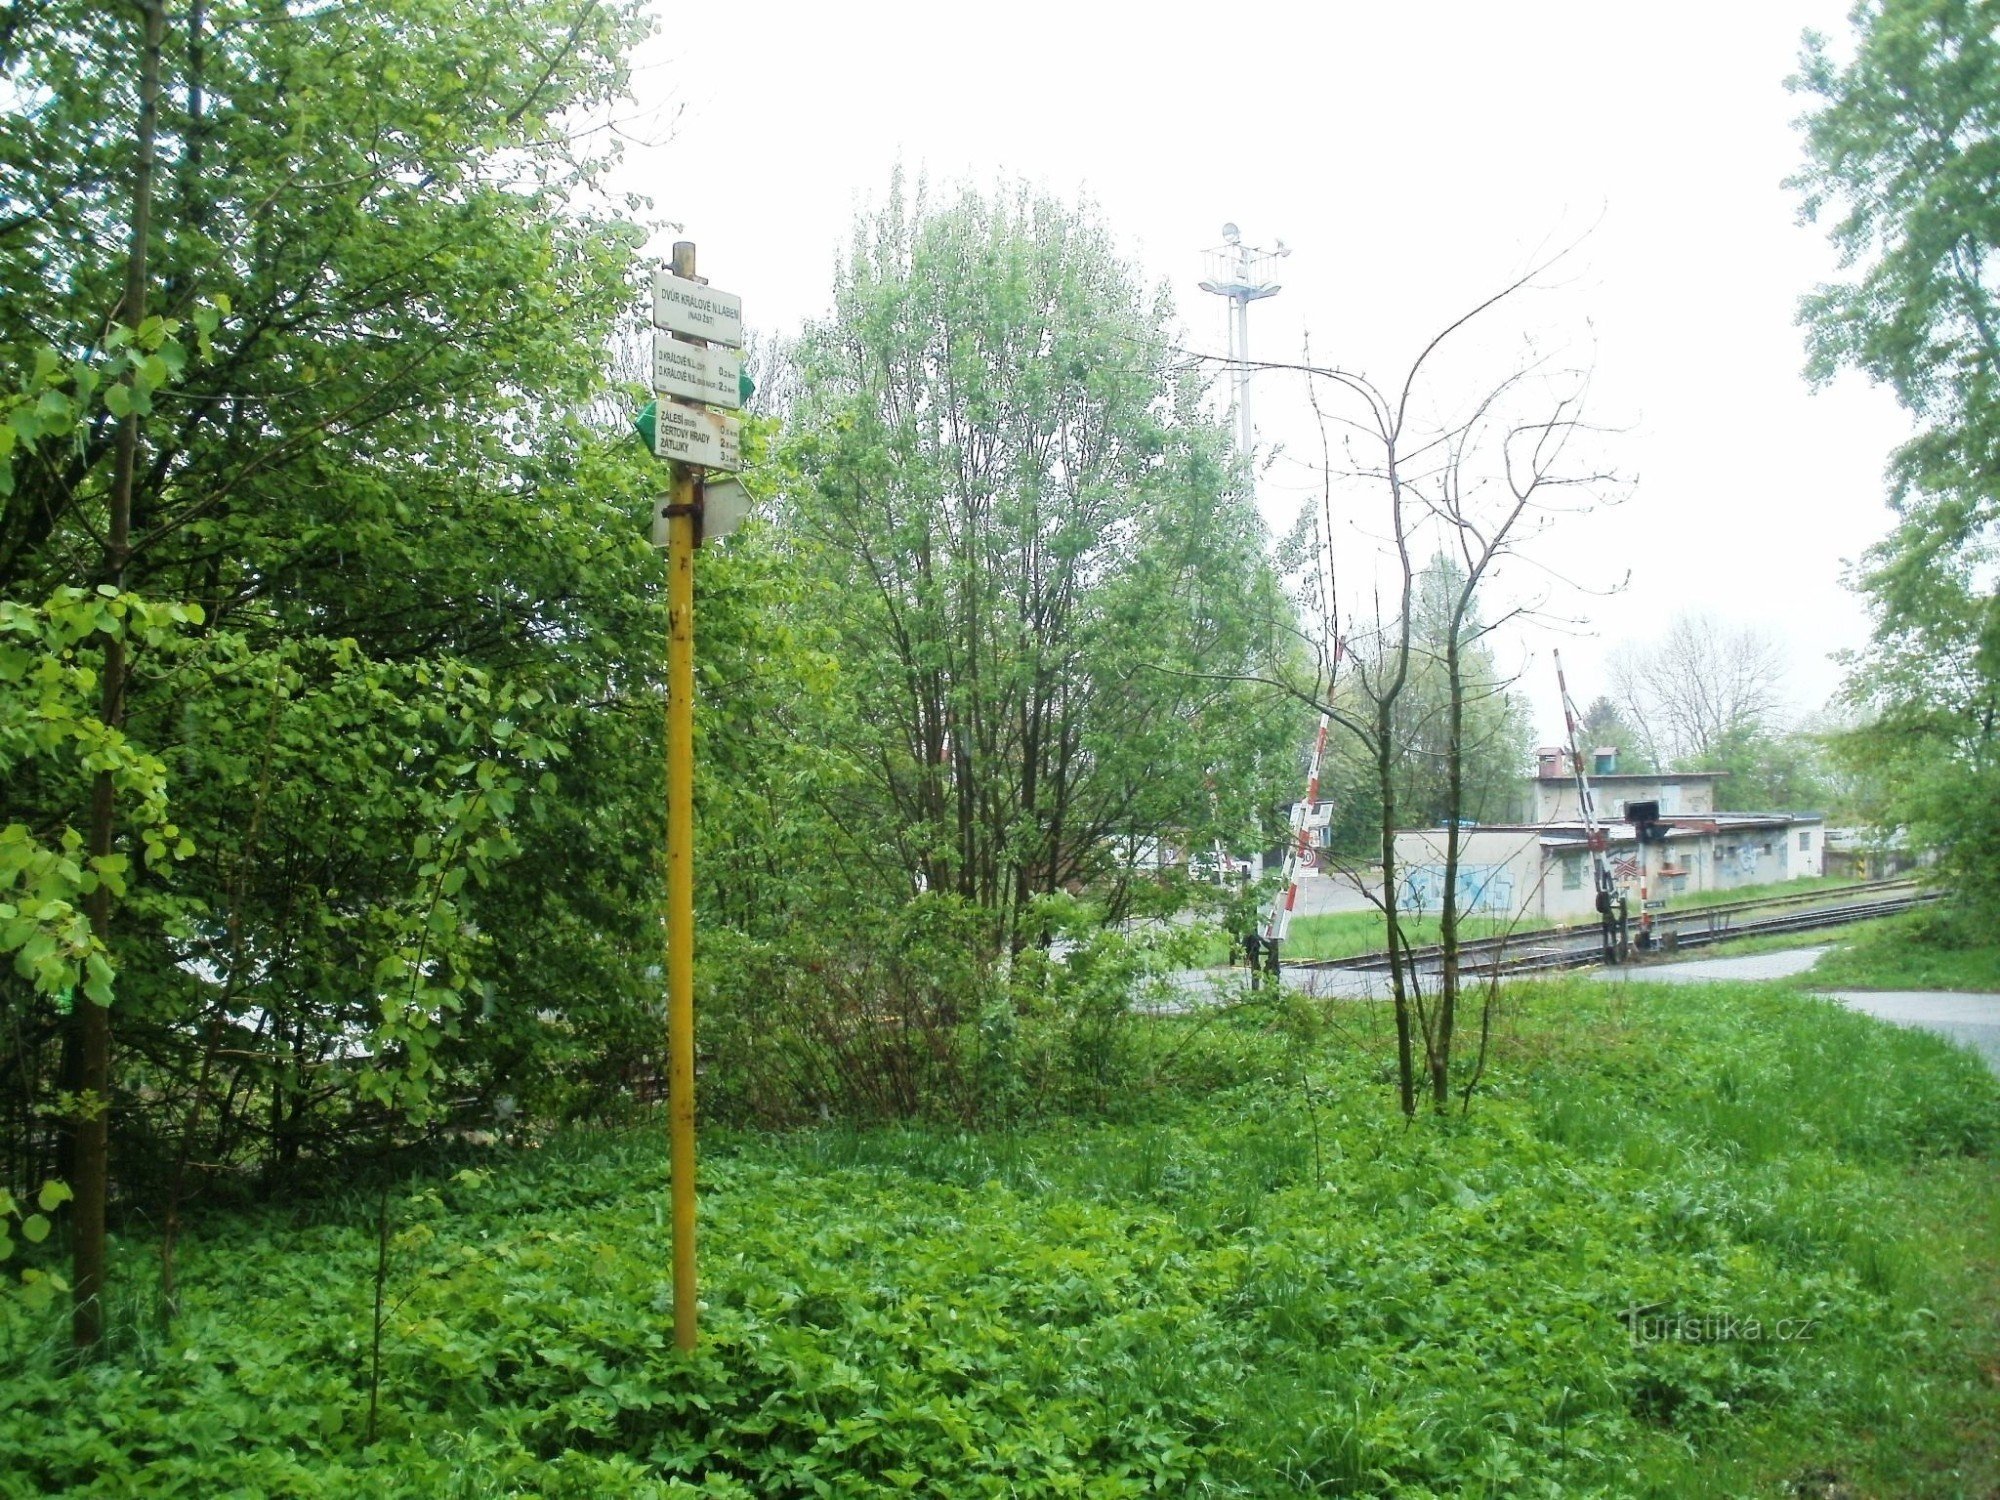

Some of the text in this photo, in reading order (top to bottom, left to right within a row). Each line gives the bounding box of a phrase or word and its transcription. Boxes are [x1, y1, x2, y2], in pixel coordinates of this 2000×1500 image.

[661, 288, 680, 303] DVŮR
[681, 294, 711, 311] KRÁLOVÉ
[661, 408, 684, 425] ZÁLESÍ
[661, 423, 710, 444] ČERTOVY HRADY
[660, 437, 689, 453] ZÁTLUKY
